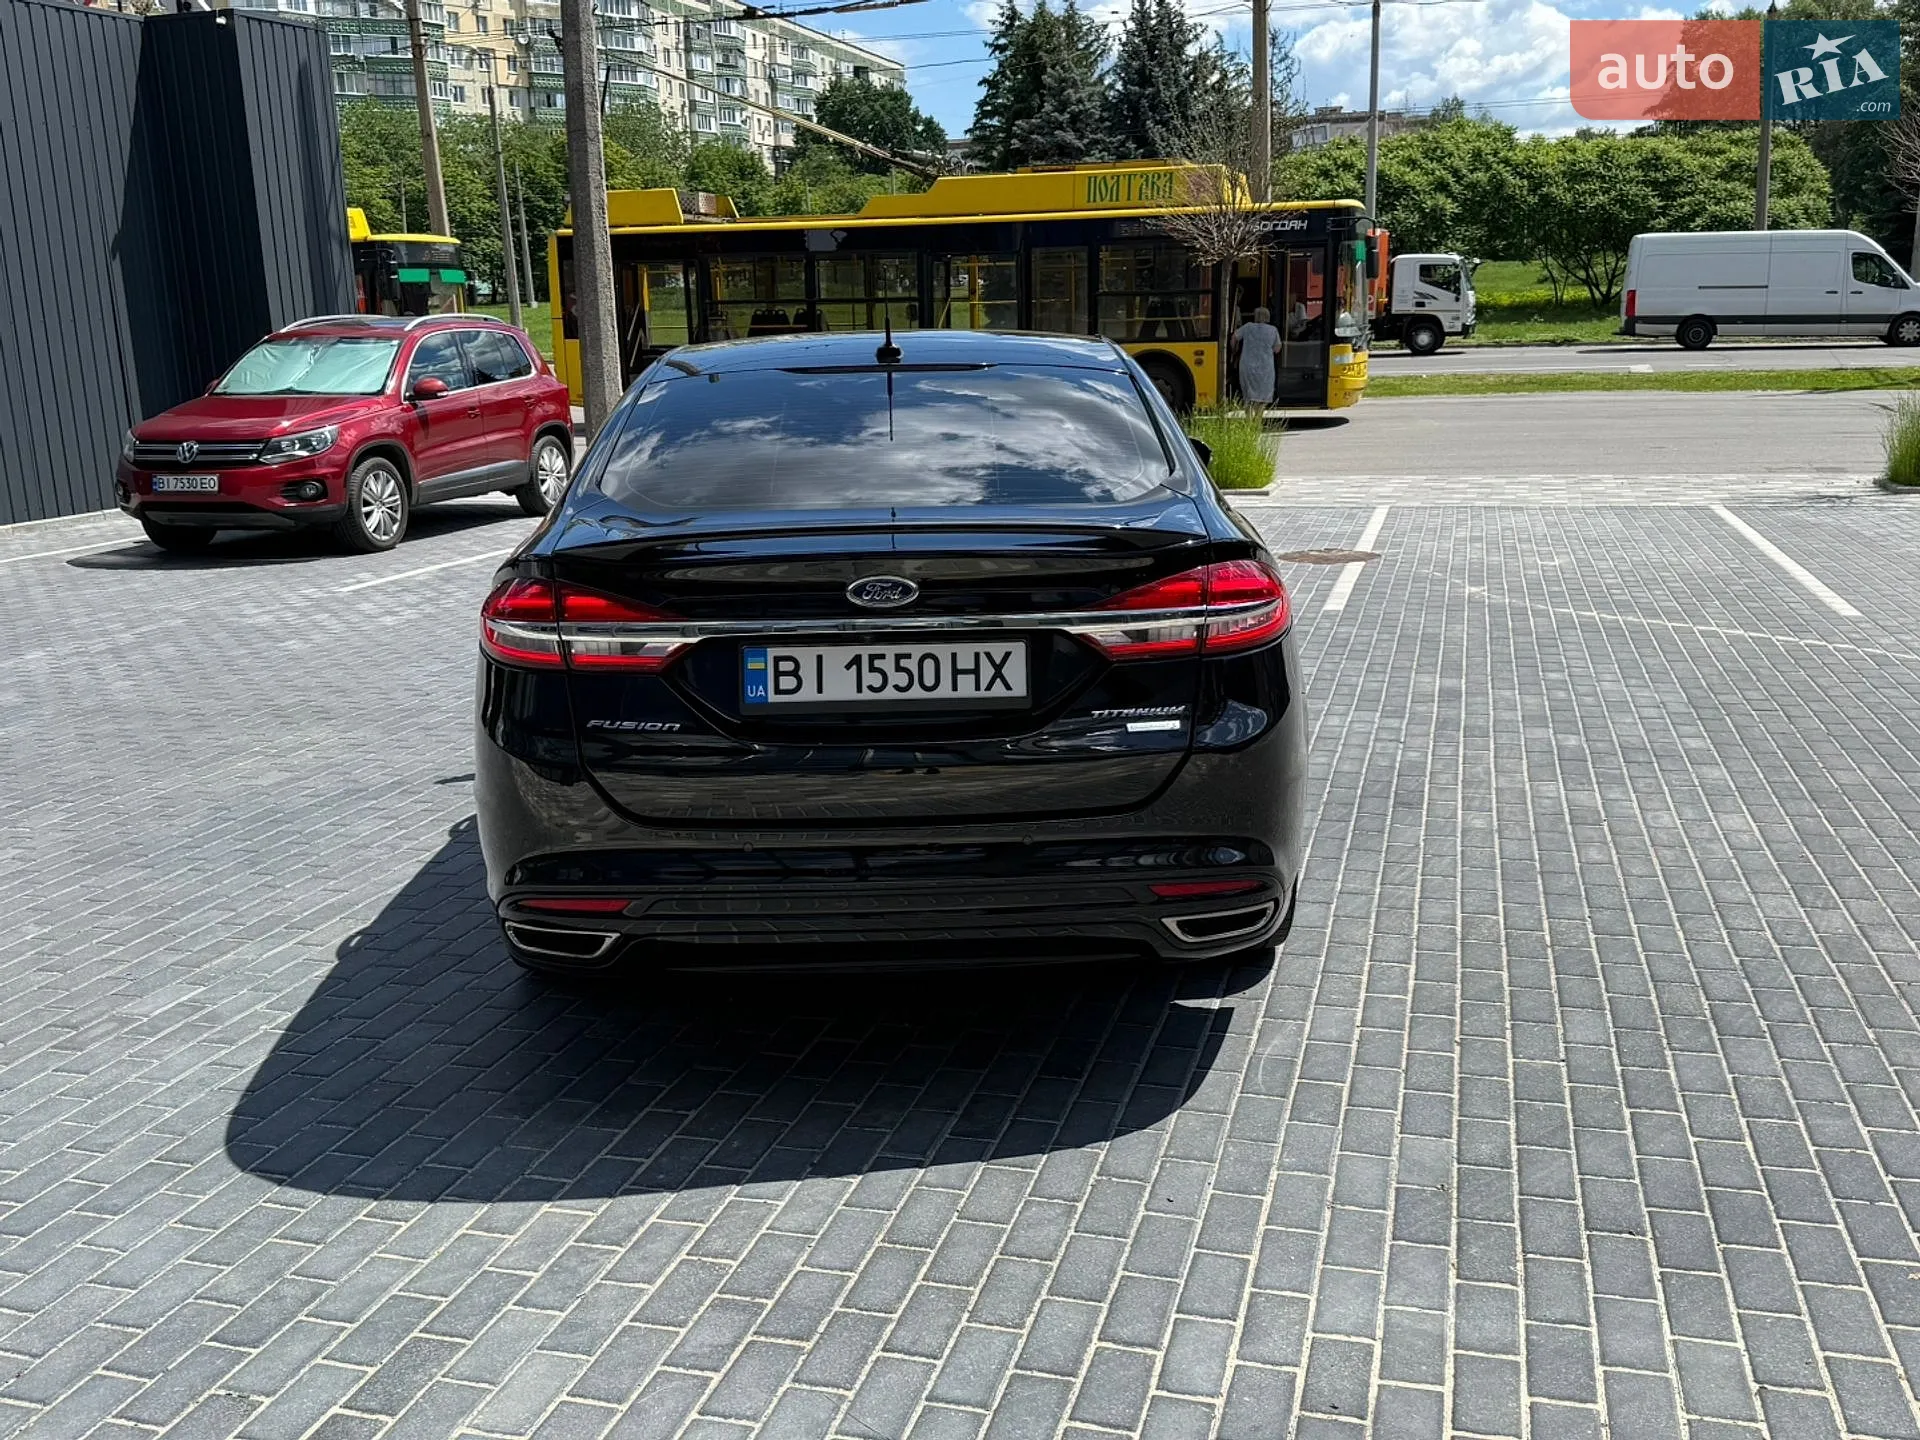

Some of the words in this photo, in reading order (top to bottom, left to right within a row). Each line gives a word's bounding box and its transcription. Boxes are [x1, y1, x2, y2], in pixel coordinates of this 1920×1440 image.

[1086, 171, 1175, 204] ПОЛТАВА
[861, 582, 903, 600] Ford
[772, 654, 824, 696] BI
[747, 684, 766, 698] UA
[586, 719, 681, 732] FUSION
